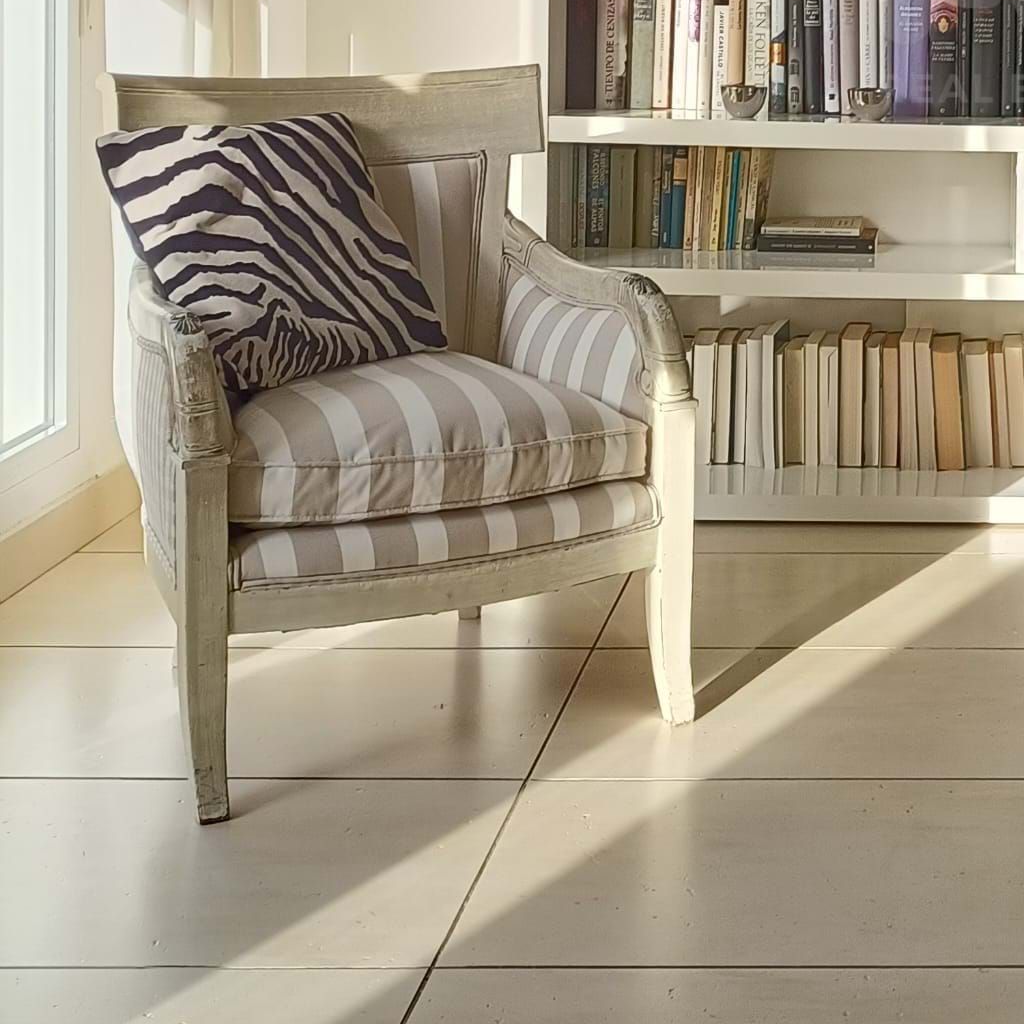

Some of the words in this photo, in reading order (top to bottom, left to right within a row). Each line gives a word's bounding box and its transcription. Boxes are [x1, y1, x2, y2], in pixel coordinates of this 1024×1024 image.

[756, 2, 767, 29] KEN
[606, 40, 614, 52] DE
[754, 33, 766, 87] FOLLETT
[605, 55, 615, 94] TIEMPO
[592, 149, 600, 189] FALCONES
